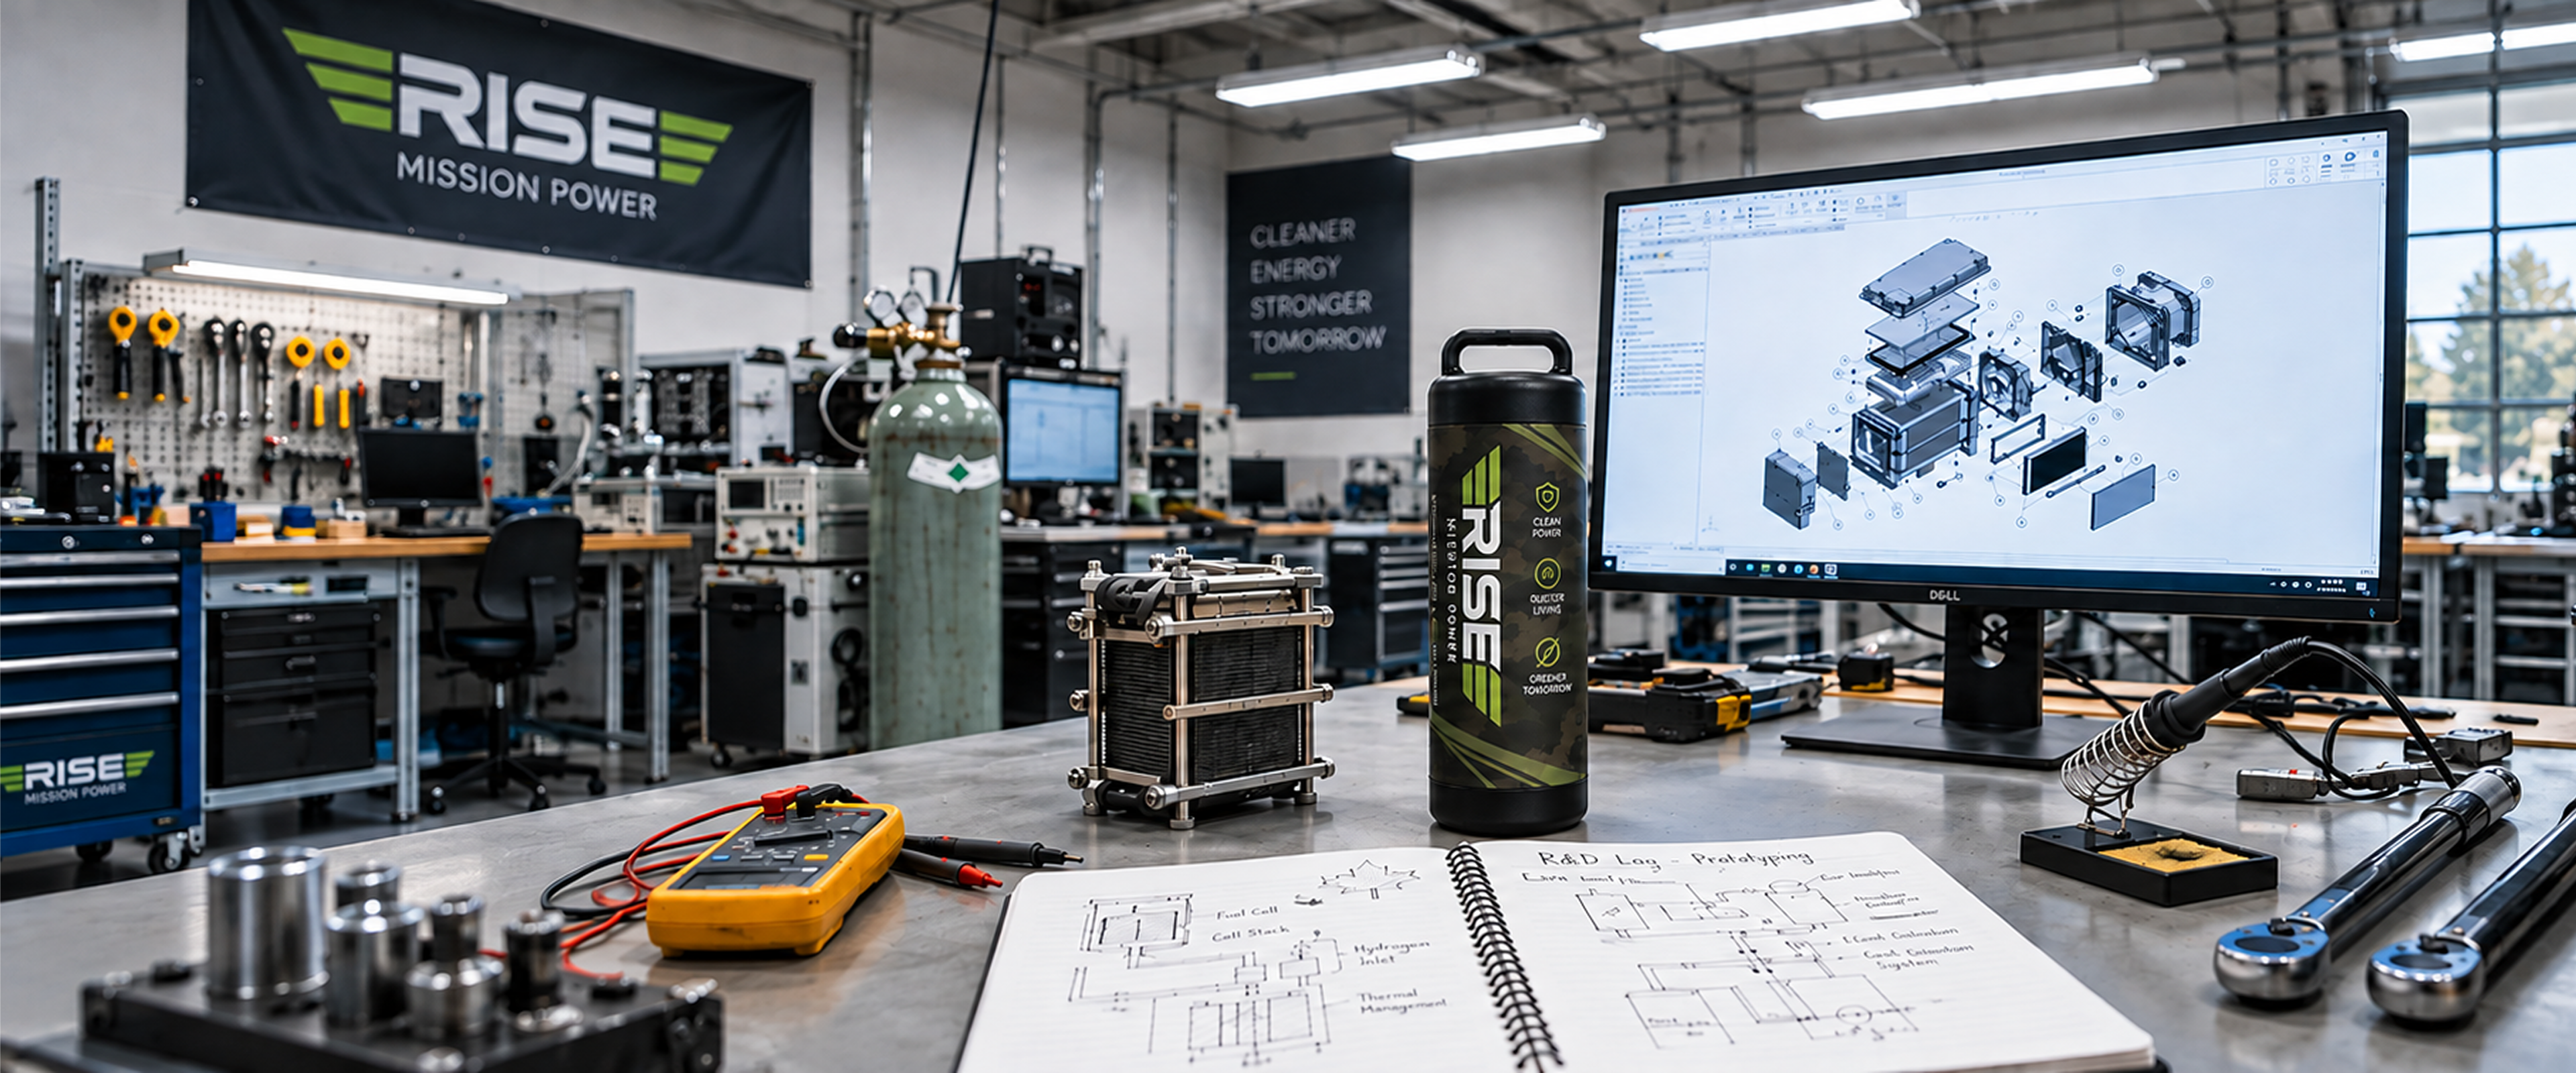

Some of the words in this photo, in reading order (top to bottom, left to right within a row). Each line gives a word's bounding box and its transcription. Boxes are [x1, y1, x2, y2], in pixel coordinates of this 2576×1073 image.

[398, 52, 657, 179] RISE
[397, 152, 540, 203] MISSION
[550, 177, 657, 221] POWER
[1250, 217, 1356, 249] CLEANER
[1250, 255, 1342, 284] ENERGY
[1250, 290, 1373, 321] STRONGER
[1250, 325, 1387, 354] TOMORROW
[1533, 517, 1562, 526] CLEAN
[1462, 500, 1501, 672] RISE
[1929, 589, 1960, 601] DELL
[25, 752, 125, 790] RISE
[25, 789, 78, 805] MISSION
[82, 782, 126, 798] POWER
[1538, 852, 1599, 865] R&D
